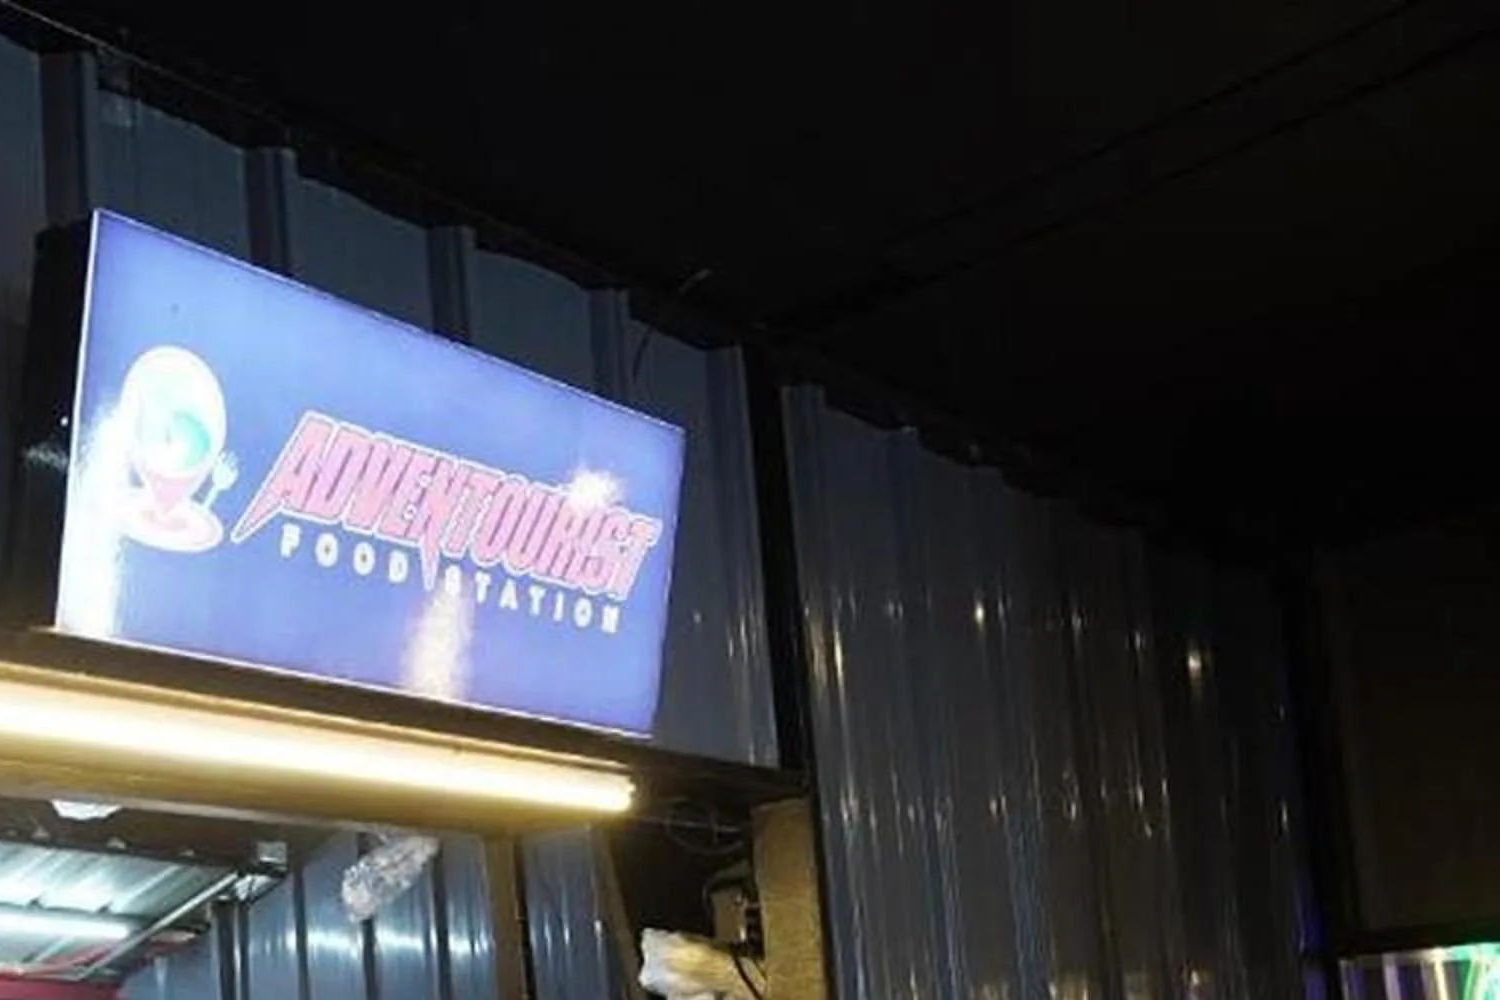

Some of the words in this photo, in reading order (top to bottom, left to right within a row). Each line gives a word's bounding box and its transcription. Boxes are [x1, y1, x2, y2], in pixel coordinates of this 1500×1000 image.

[230, 409, 663, 602] ADVENTOURIST
[280, 523, 410, 583] FOOD
[443, 564, 622, 634] STATION
